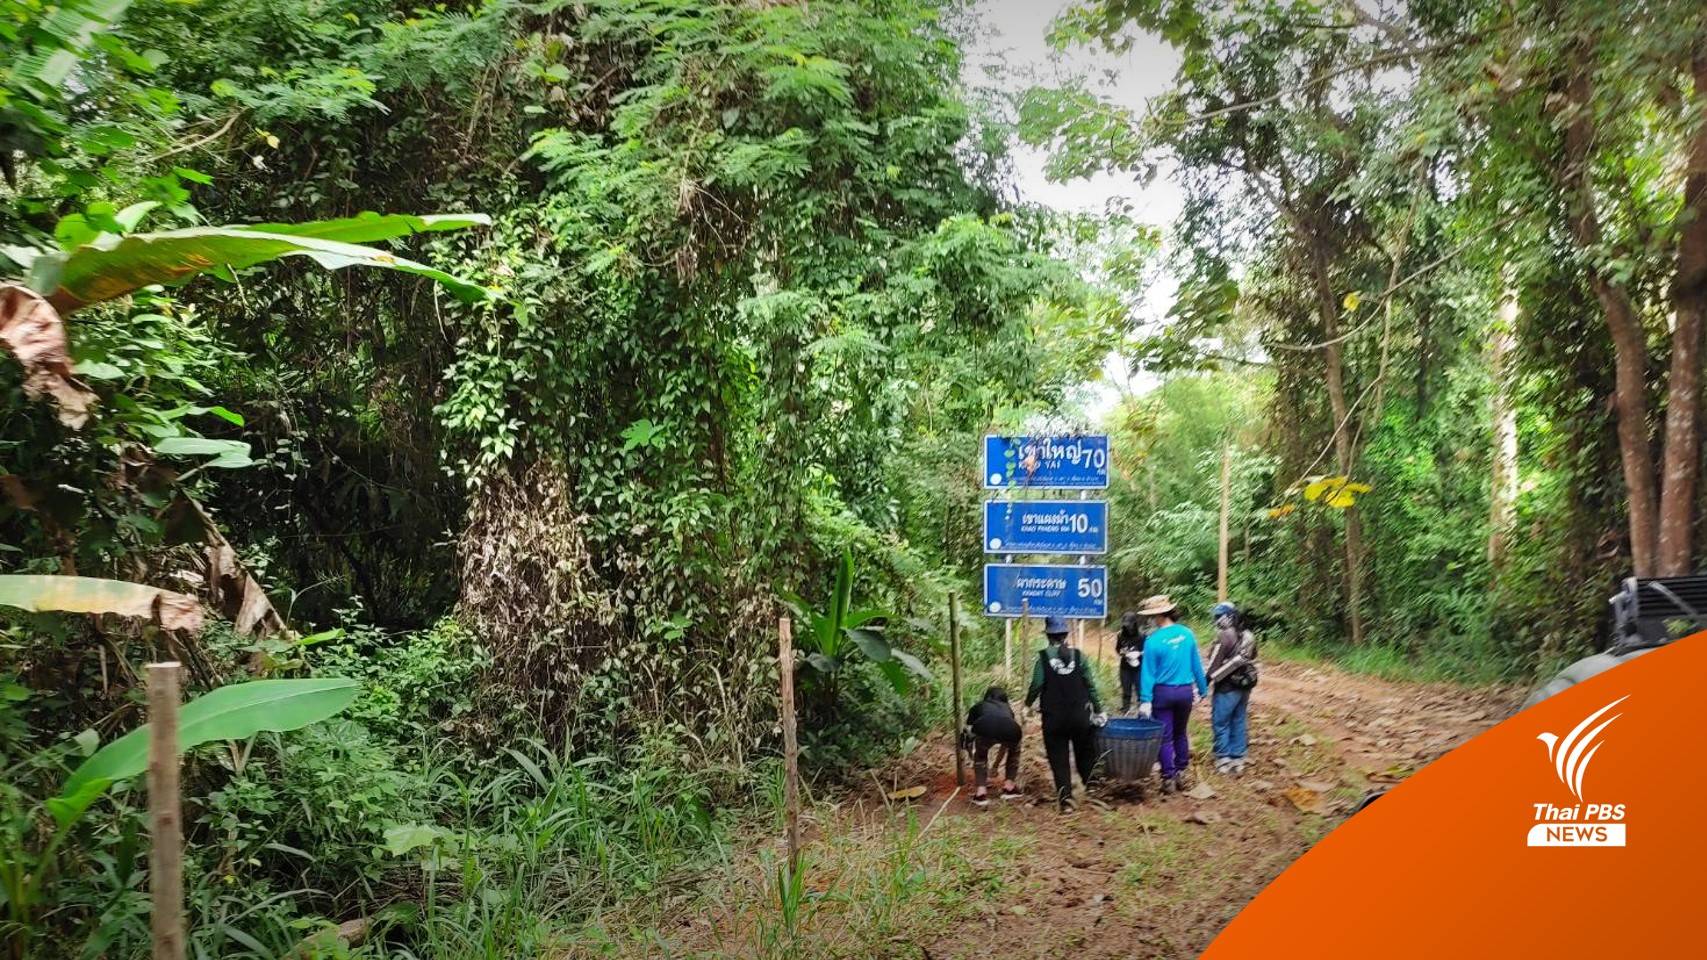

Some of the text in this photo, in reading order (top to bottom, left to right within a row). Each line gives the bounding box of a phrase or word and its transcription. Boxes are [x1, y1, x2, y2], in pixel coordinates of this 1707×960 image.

[1081, 448, 1106, 469] 70
[1069, 513, 1089, 533] 10
[1077, 578, 1103, 598] 50
